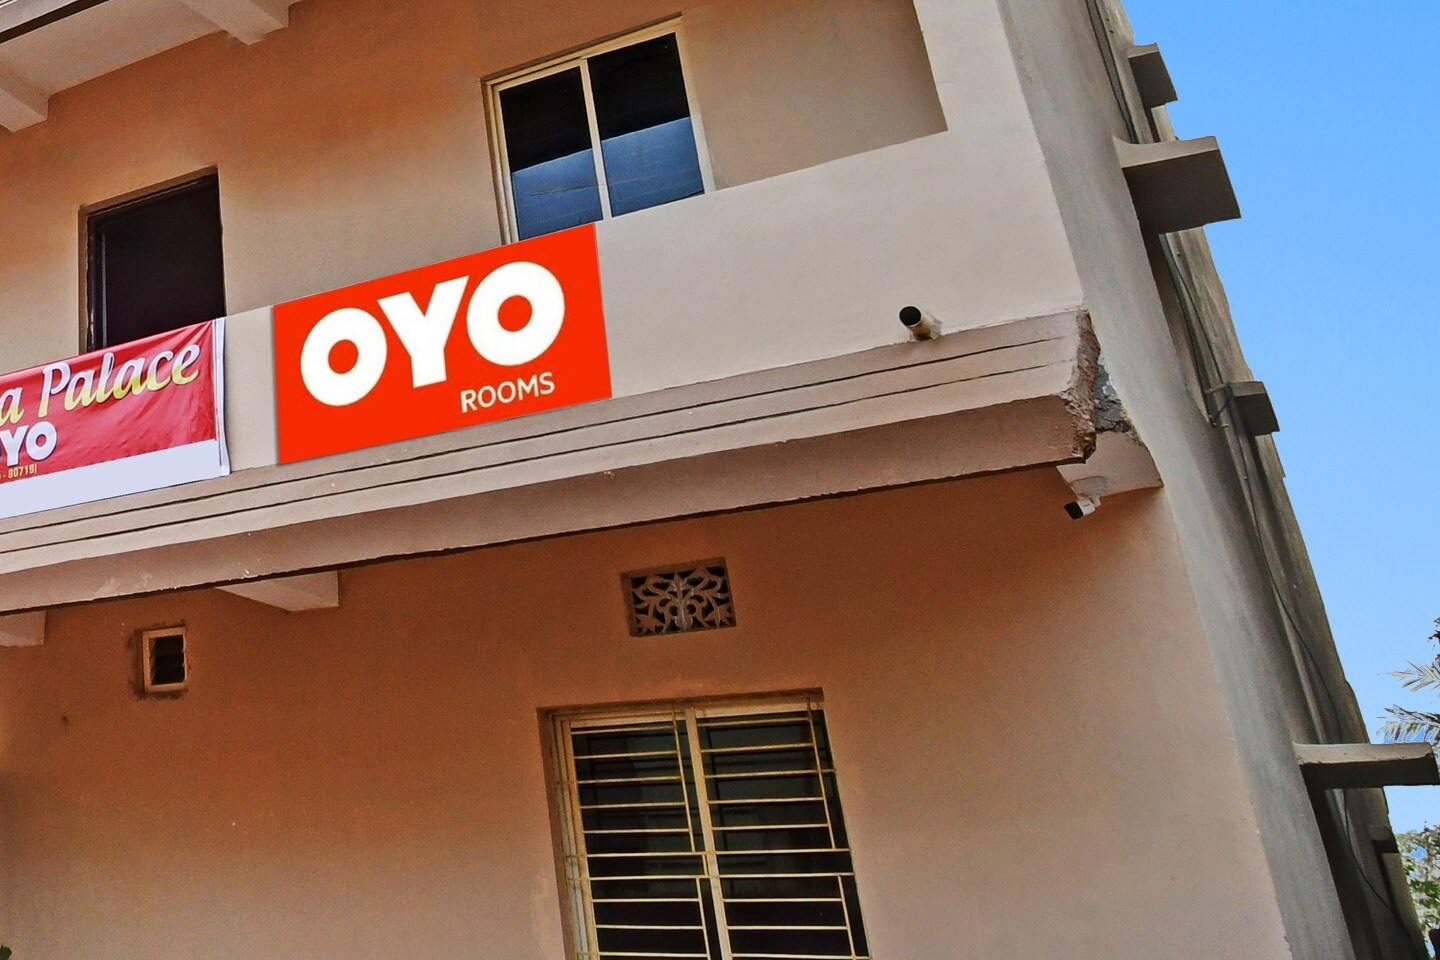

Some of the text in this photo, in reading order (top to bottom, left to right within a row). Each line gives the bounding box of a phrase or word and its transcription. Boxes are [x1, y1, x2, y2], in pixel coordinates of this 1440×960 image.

[300, 261, 566, 407] OYO
[37, 343, 201, 418] Palace
[460, 371, 556, 414] ROOMS
